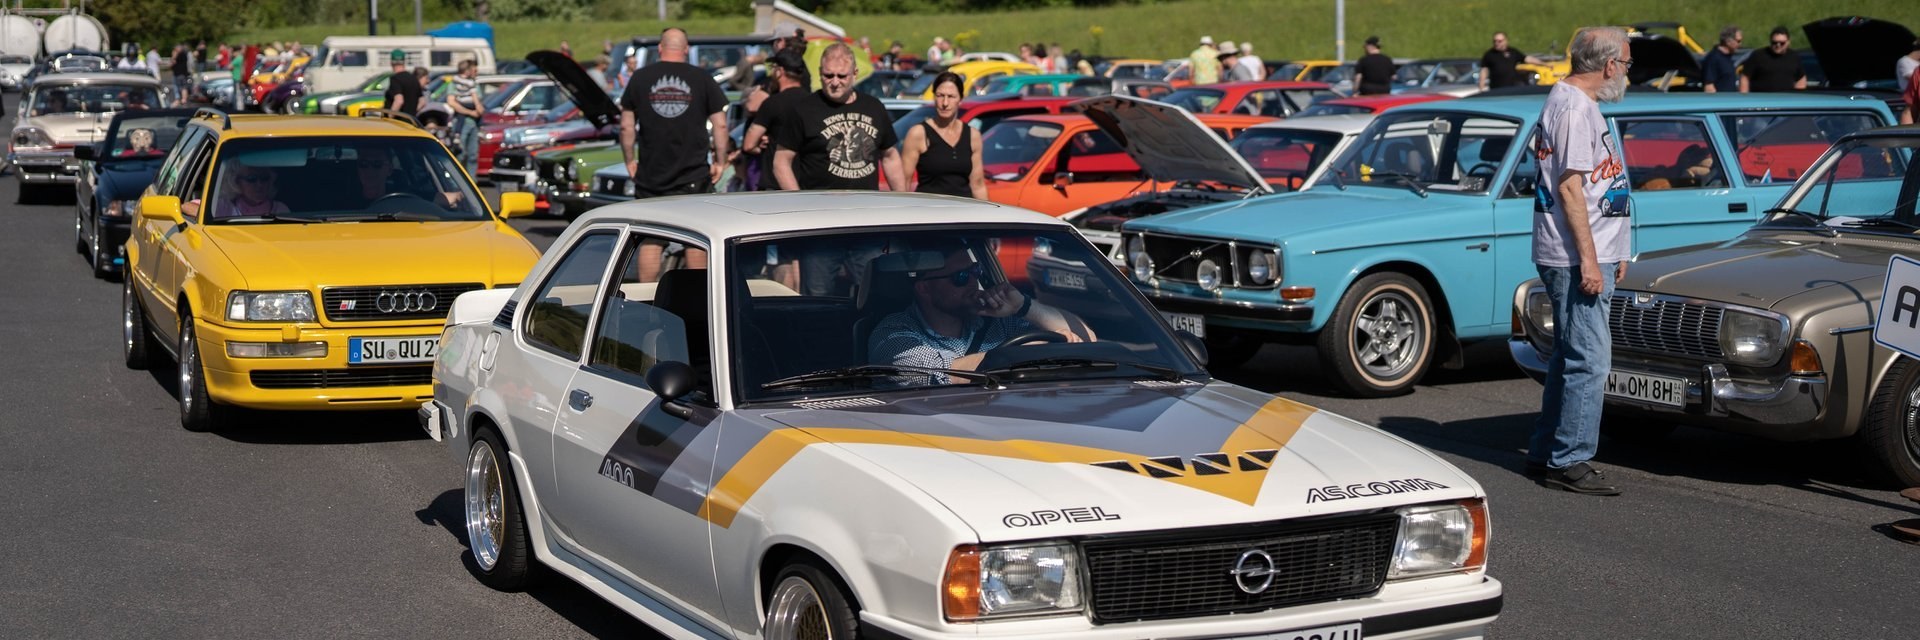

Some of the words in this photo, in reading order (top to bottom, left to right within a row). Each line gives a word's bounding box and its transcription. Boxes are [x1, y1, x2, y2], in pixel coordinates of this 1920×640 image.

[823, 113, 845, 126] KOMM
[846, 112, 860, 121] AUF
[828, 162, 876, 179] VERBRENNER
[363, 341, 384, 359] SU
[399, 340, 420, 358] QU
[1604, 373, 1617, 393] W
[1628, 376, 1648, 398] OM
[1652, 380, 1673, 402] 8H
[602, 458, 635, 489] 400
[1306, 478, 1450, 504] ASCONA
[1002, 506, 1121, 528] OPEL
